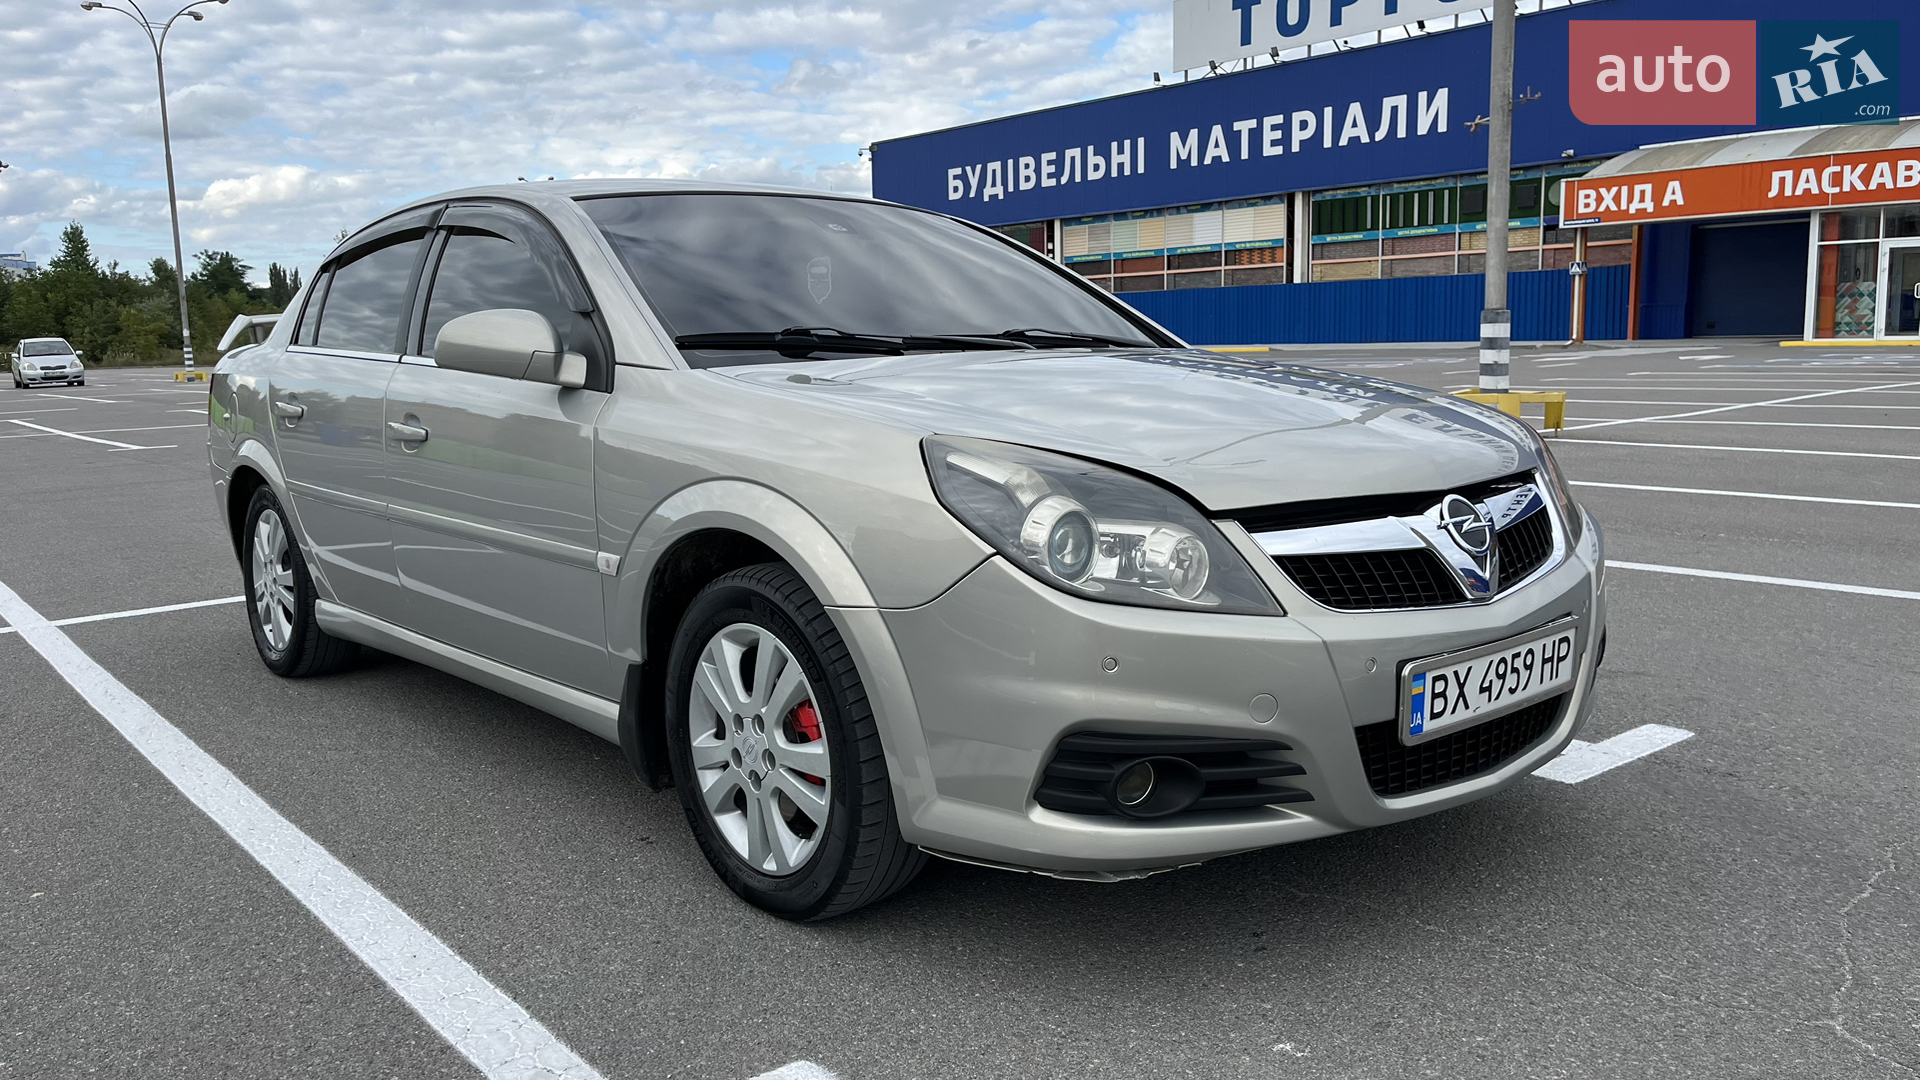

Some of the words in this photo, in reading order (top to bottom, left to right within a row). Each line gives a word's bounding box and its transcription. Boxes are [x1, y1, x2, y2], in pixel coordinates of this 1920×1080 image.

[947, 136, 1145, 201] БУДІВЕЛЬНІ
[1169, 87, 1449, 169] МАТЕРІАЛИ
[1577, 182, 1654, 215] ВХІД
[1661, 180, 1685, 207] А
[1767, 159, 1920, 199] ЛАСКАВ
[1430, 665, 1473, 721] BX
[1478, 648, 1535, 703] 4959
[1540, 635, 1571, 685] HP
